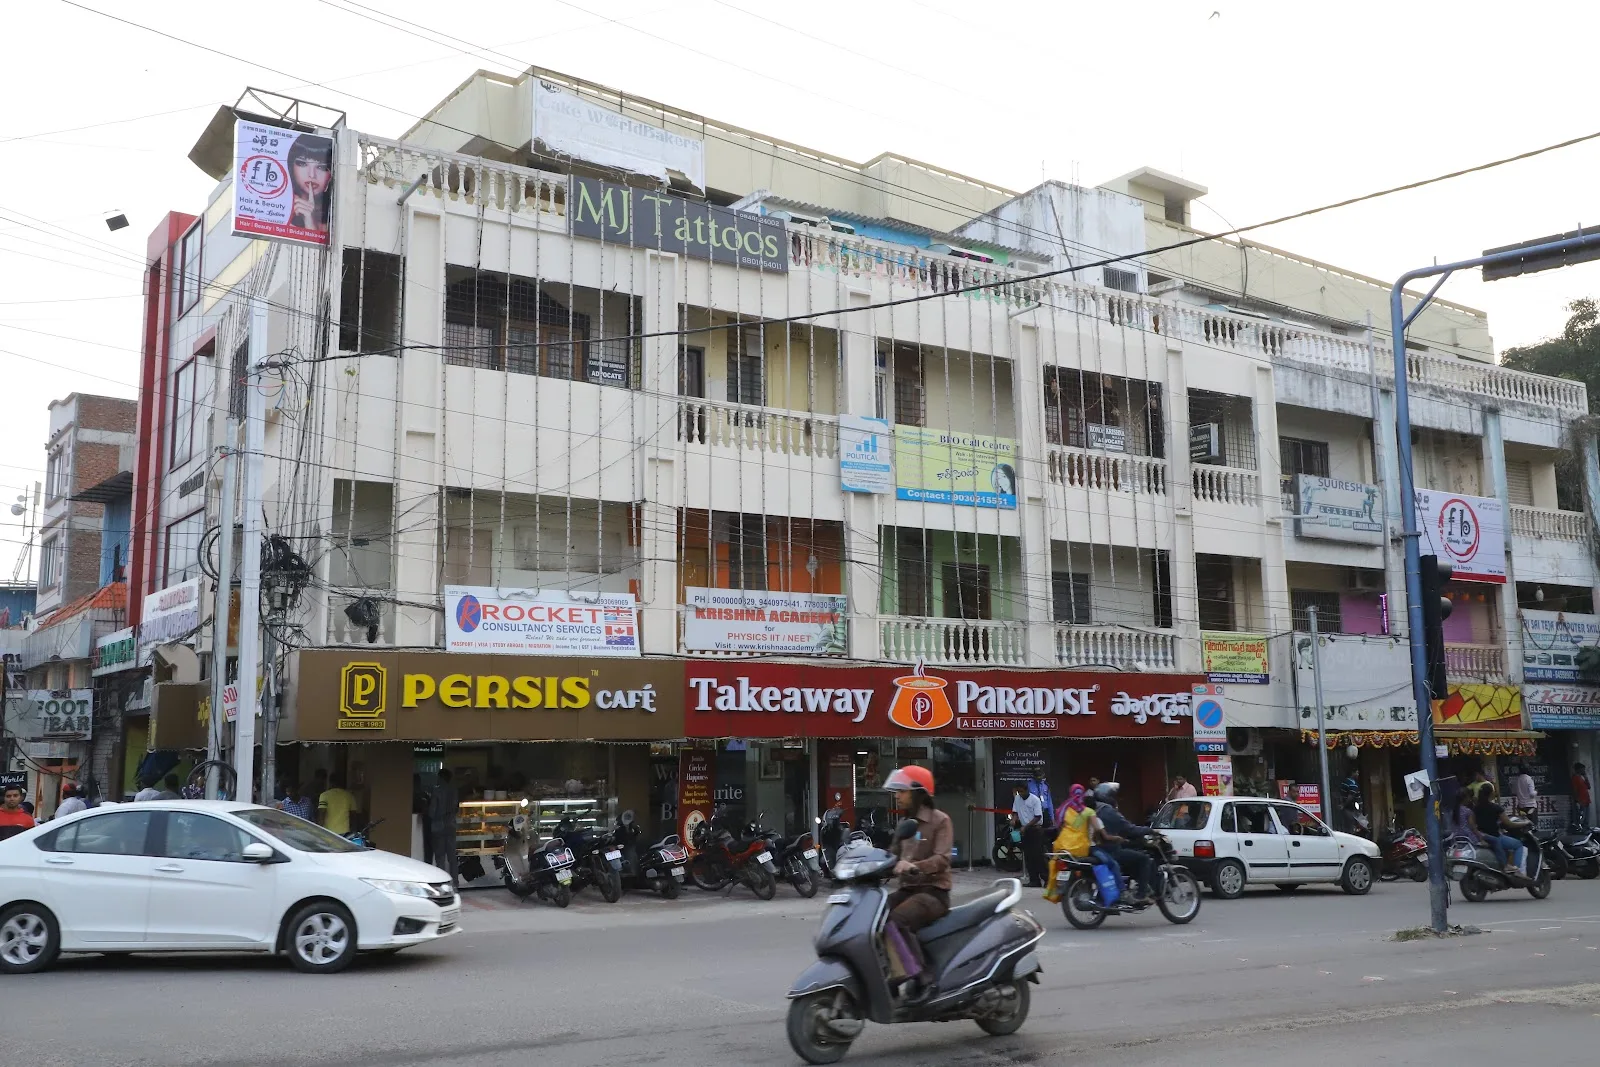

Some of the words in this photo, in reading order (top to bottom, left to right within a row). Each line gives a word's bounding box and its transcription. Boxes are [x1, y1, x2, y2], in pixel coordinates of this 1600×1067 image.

[539, 95, 581, 119] Cake
[240, 205, 254, 213] Only
[262, 201, 286, 210] Beauty
[575, 182, 631, 235] MJ
[642, 195, 779, 258] Tattoos
[254, 223, 272, 231] Beauty
[962, 438, 980, 448] Call
[982, 440, 1011, 451] Centre
[846, 452, 879, 462] POLITICAL
[1318, 478, 1362, 492] SUURESH
[908, 489, 944, 500] Contact
[482, 604, 602, 624] ROCKET
[696, 608, 766, 622] KRISHNA
[769, 611, 840, 624] ACADEMY
[482, 622, 553, 634] CONSULTANCY
[556, 625, 602, 636] SERVICES
[1556, 622, 1585, 633] OMPUTER
[728, 633, 767, 641] PHYSICS
[402, 674, 591, 709] PERSIS
[595, 684, 657, 712] CAFÉ
[690, 676, 874, 723] Takeaway
[1530, 704, 1561, 714] ELECTRIC
[1562, 706, 1574, 715] DRY
[962, 720, 970, 728] A
[971, 720, 1008, 728] LEGEND.
[1010, 720, 1035, 728] SINCE
[1036, 720, 1056, 729] 1953
[1000, 757, 1026, 766] winning
[1, 776, 25, 784] World
[1299, 786, 1318, 794] RKING
